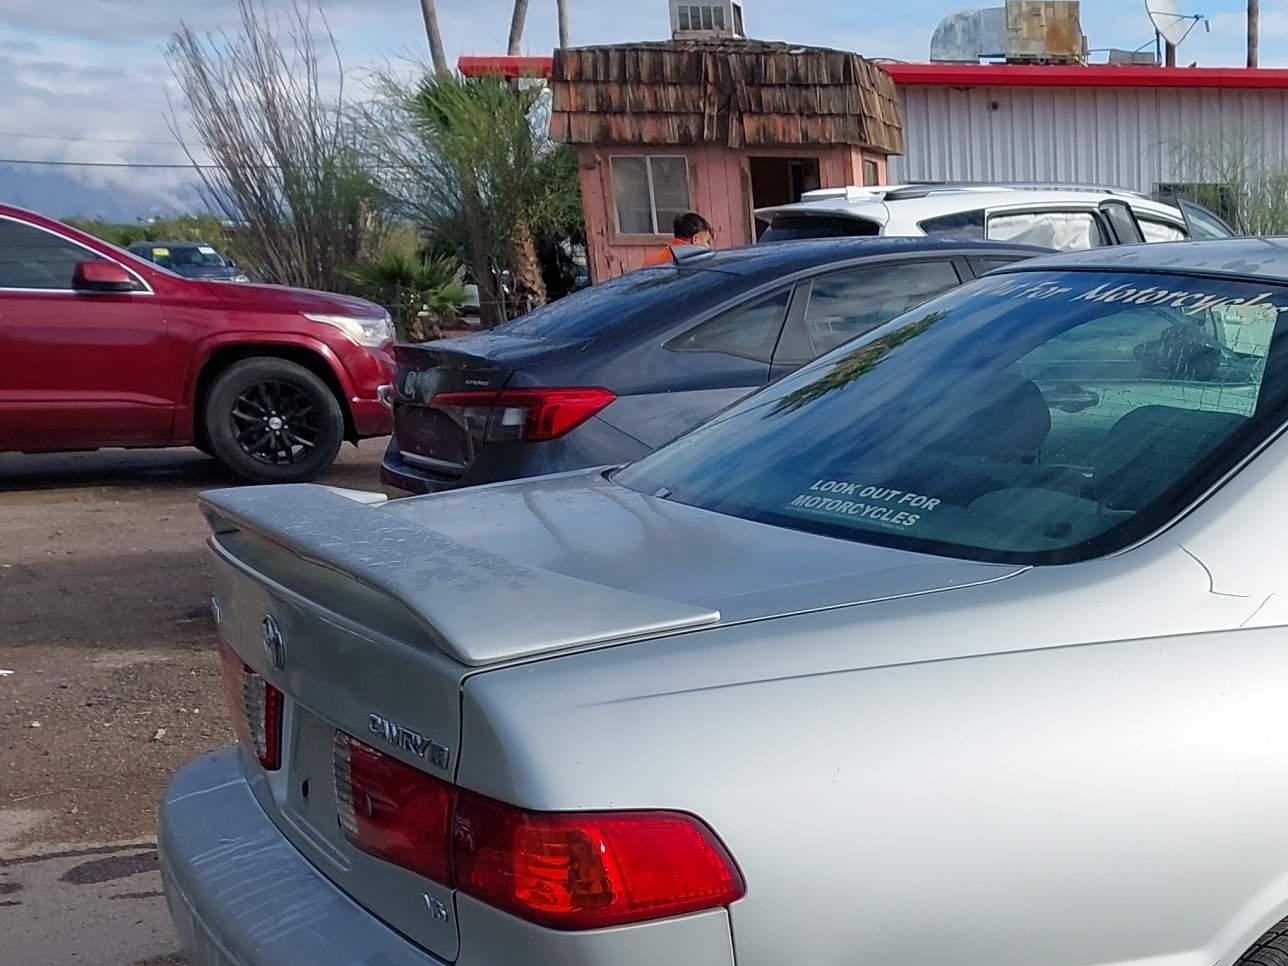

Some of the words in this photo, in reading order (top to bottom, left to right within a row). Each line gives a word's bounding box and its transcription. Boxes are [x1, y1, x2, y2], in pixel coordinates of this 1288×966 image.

[1014, 281, 1073, 300] For
[790, 494, 920, 526] MOTORCYCLES
[809, 479, 862, 495] LOOK
[859, 486, 902, 501] OUT
[897, 493, 941, 511] FOR
[368, 713, 432, 758] CAMRY
